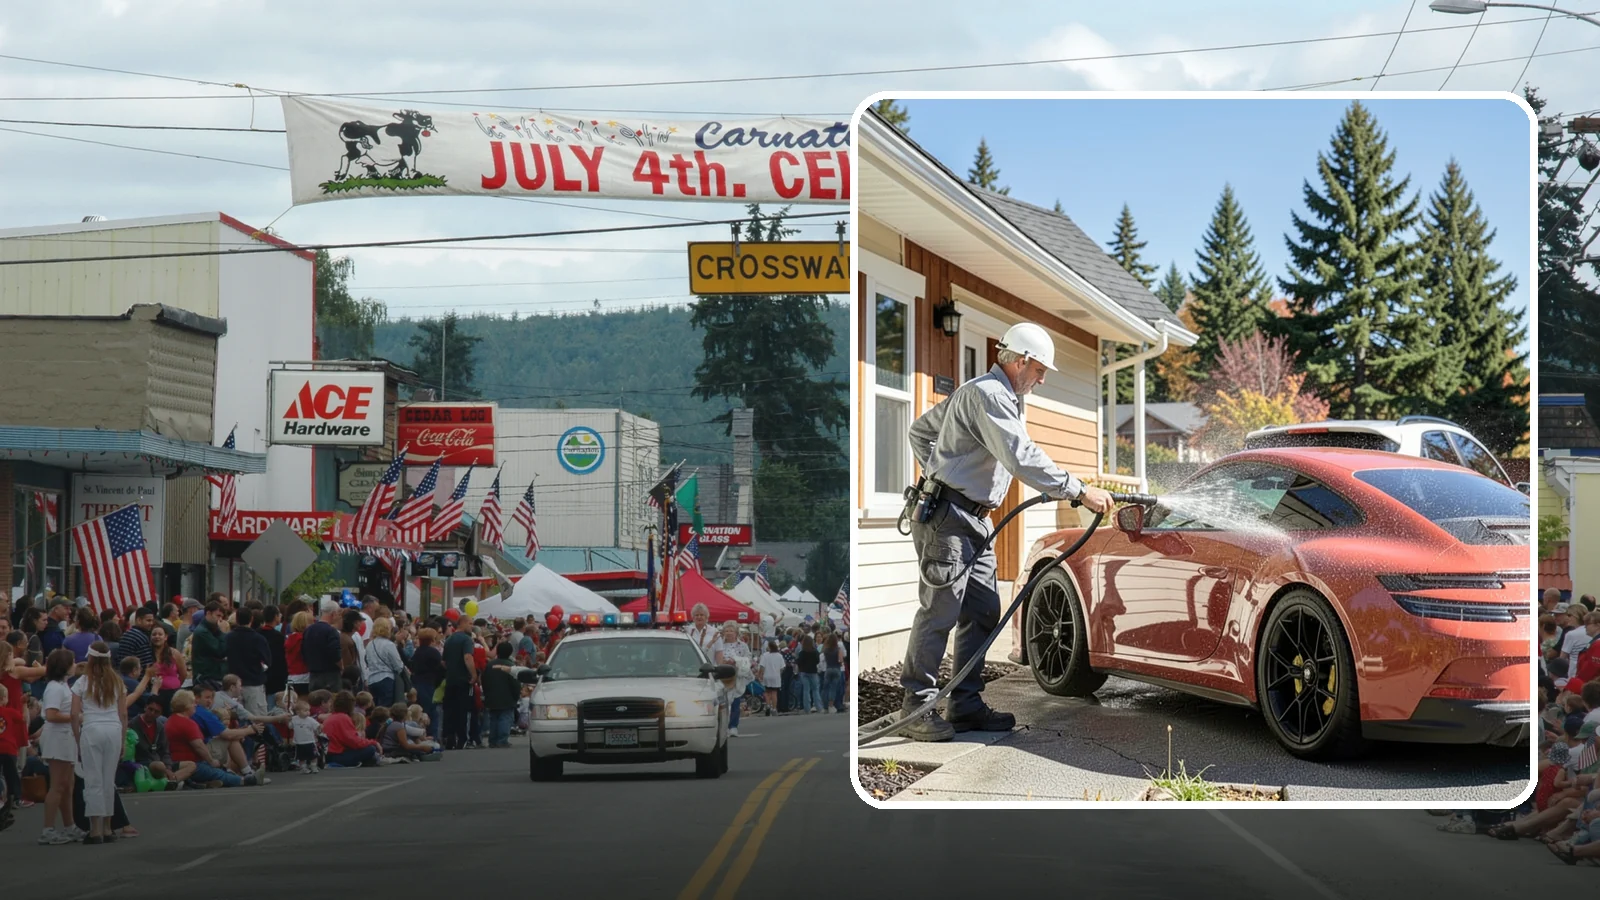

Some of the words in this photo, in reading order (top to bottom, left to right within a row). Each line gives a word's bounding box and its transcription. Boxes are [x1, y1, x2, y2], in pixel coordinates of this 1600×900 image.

[481, 141, 605, 192] JULY
[632, 150, 746, 198] 4th.
[696, 253, 850, 280] CROSSWA
[282, 380, 374, 420] ACE
[406, 409, 452, 422] CEDAR
[461, 409, 485, 422] LOG
[283, 421, 371, 437] Hardware
[416, 428, 477, 447] Coca-Cola
[354, 467, 385, 479] Simpl
[83, 485, 93, 494] St.
[96, 485, 124, 494] Vincent
[126, 485, 136, 494] de
[137, 486, 155, 495] Paul
[81, 503, 154, 522] THT
[688, 526, 741, 535] CRNATION
[698, 535, 730, 543] GLASS
